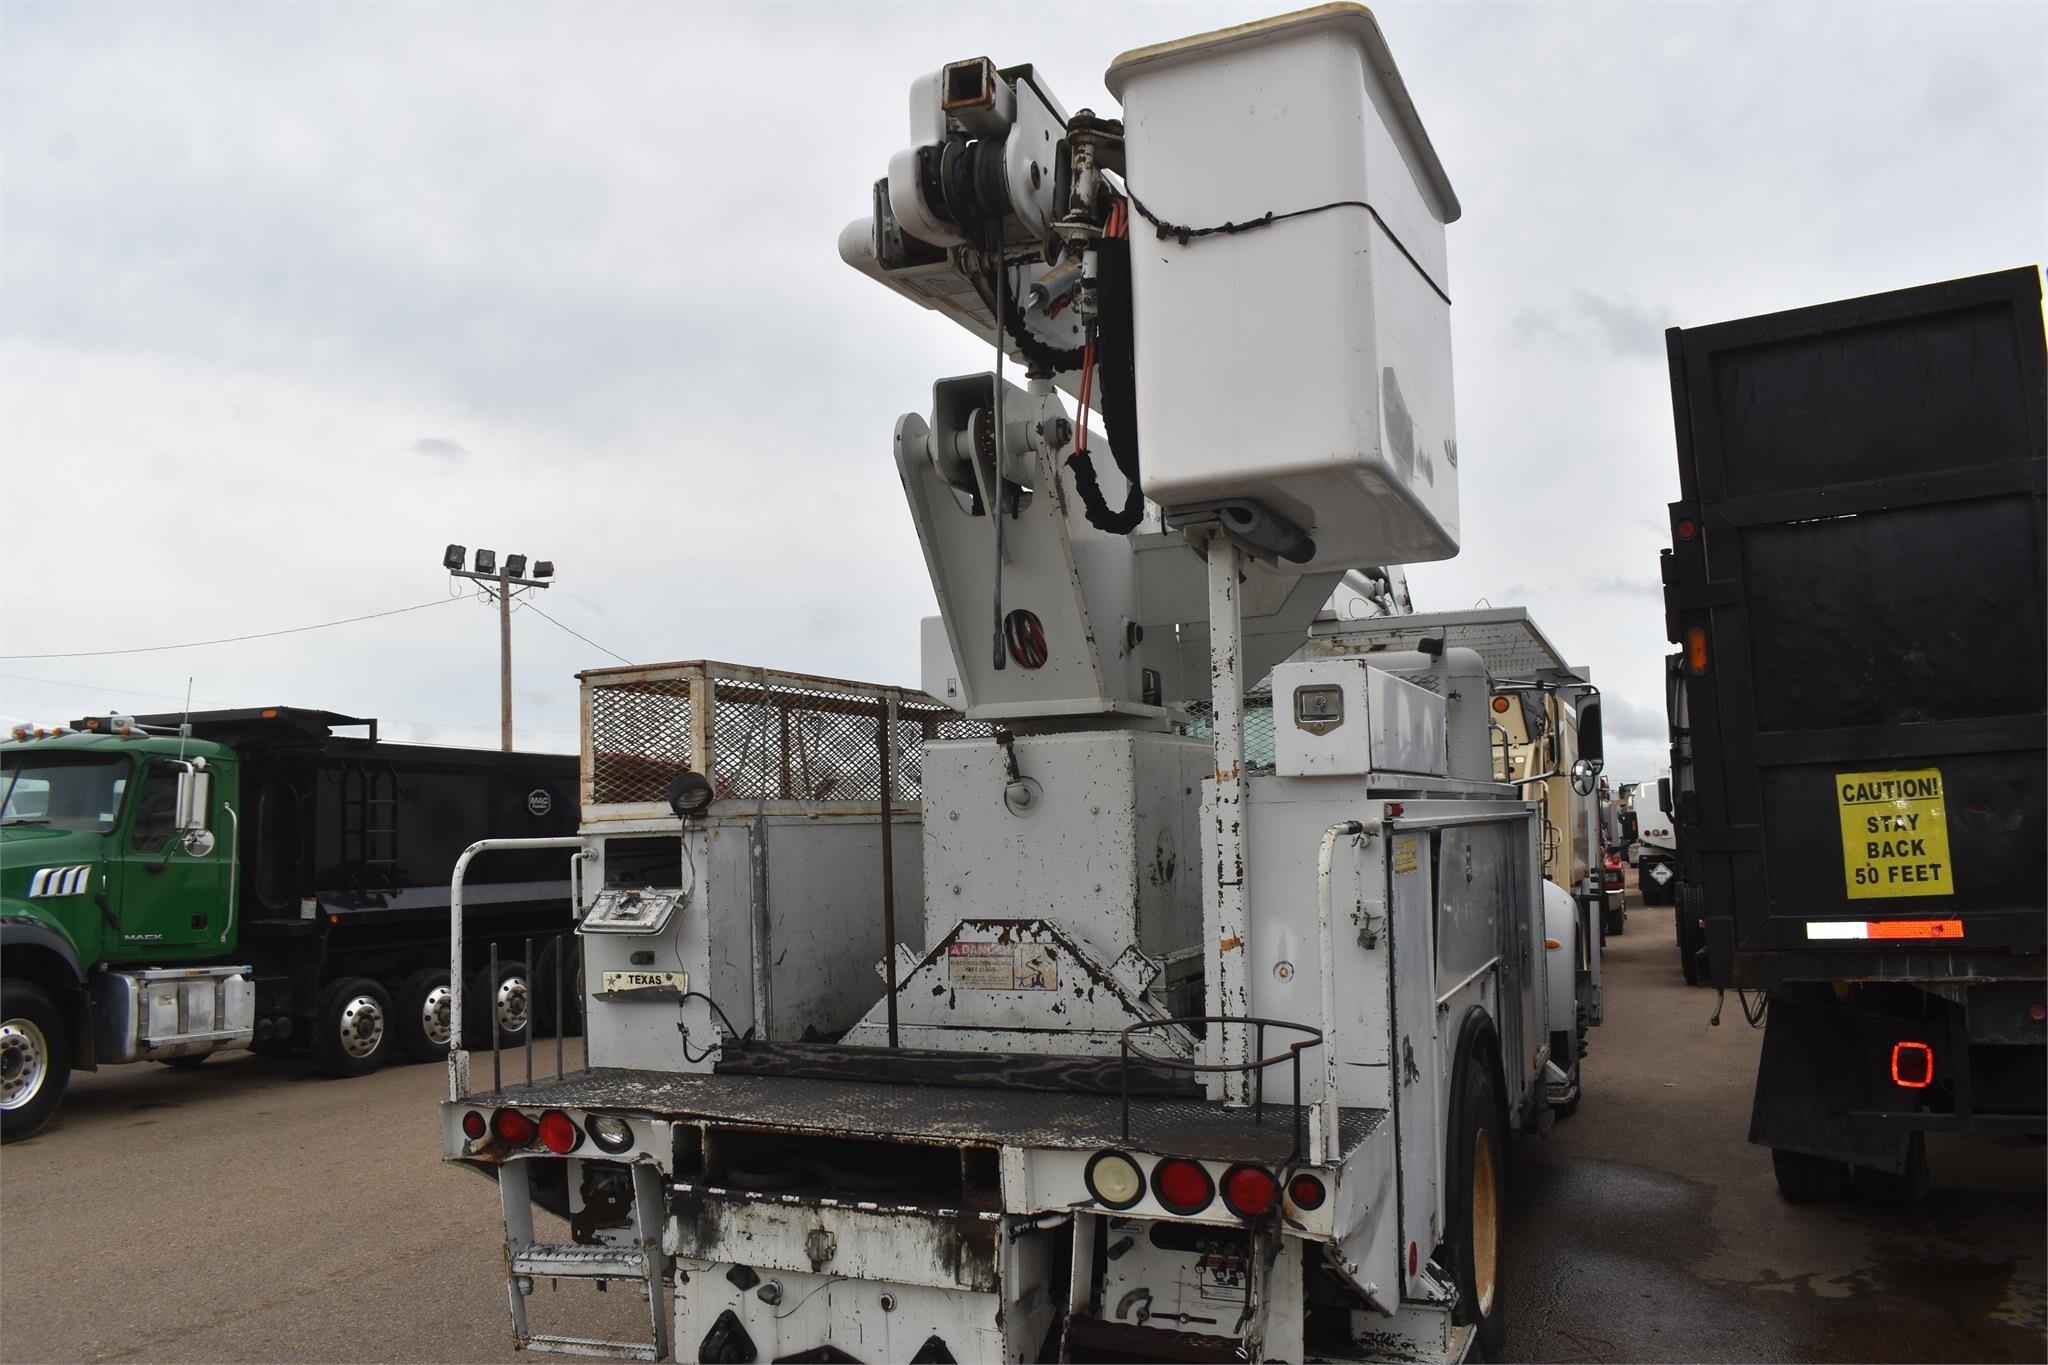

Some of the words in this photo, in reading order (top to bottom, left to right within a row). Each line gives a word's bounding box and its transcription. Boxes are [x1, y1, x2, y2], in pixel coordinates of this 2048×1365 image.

[1842, 778, 1938, 802] CAUTION!
[1867, 813, 1919, 833] STAY
[1867, 839, 1926, 859] BACK
[1855, 867, 1879, 885] 50
[1888, 863, 1942, 883] FEET
[628, 974, 662, 985] TEXAS
